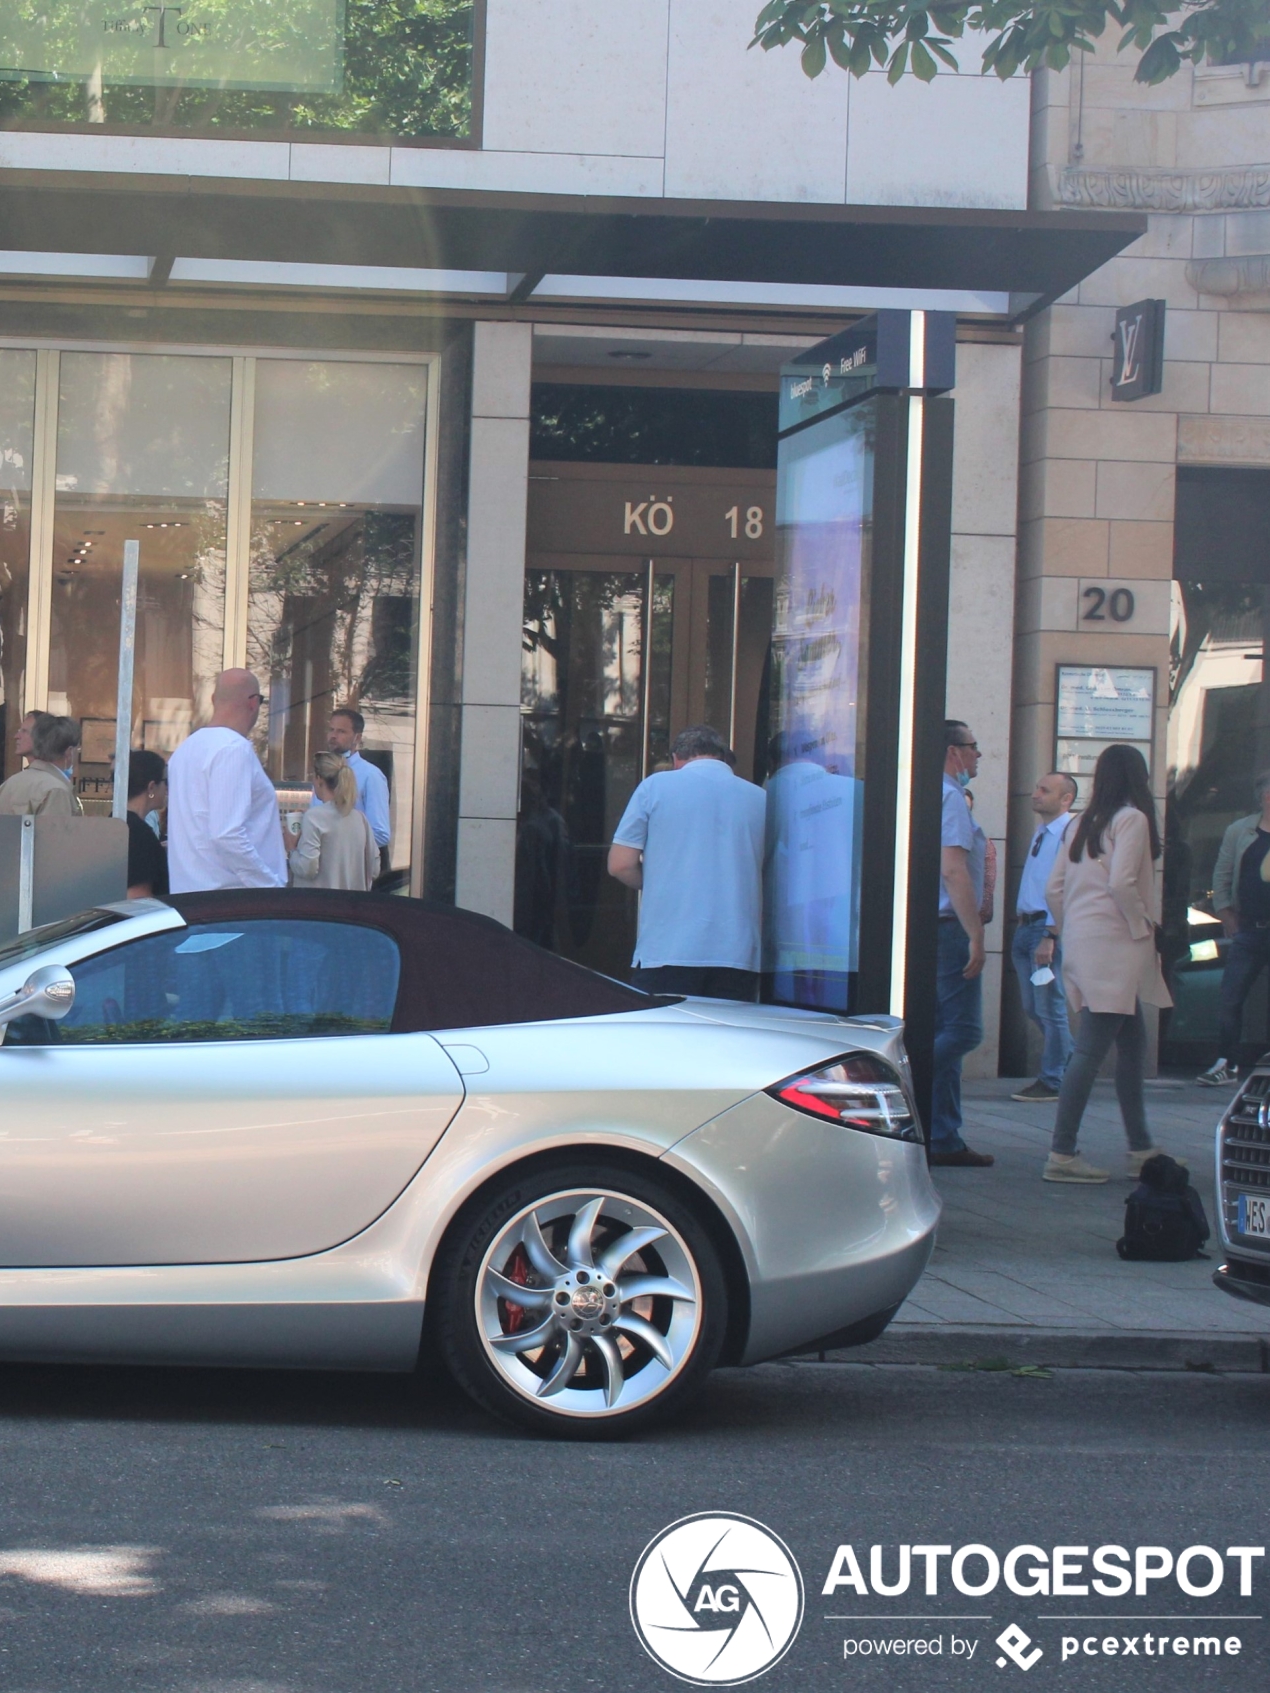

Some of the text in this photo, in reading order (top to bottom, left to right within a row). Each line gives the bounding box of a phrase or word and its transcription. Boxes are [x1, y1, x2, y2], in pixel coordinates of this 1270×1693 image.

[790, 345, 867, 400] bluespot Free WiFi
[623, 494, 764, 540] KÖ 18
[1082, 586, 1135, 623] 20
